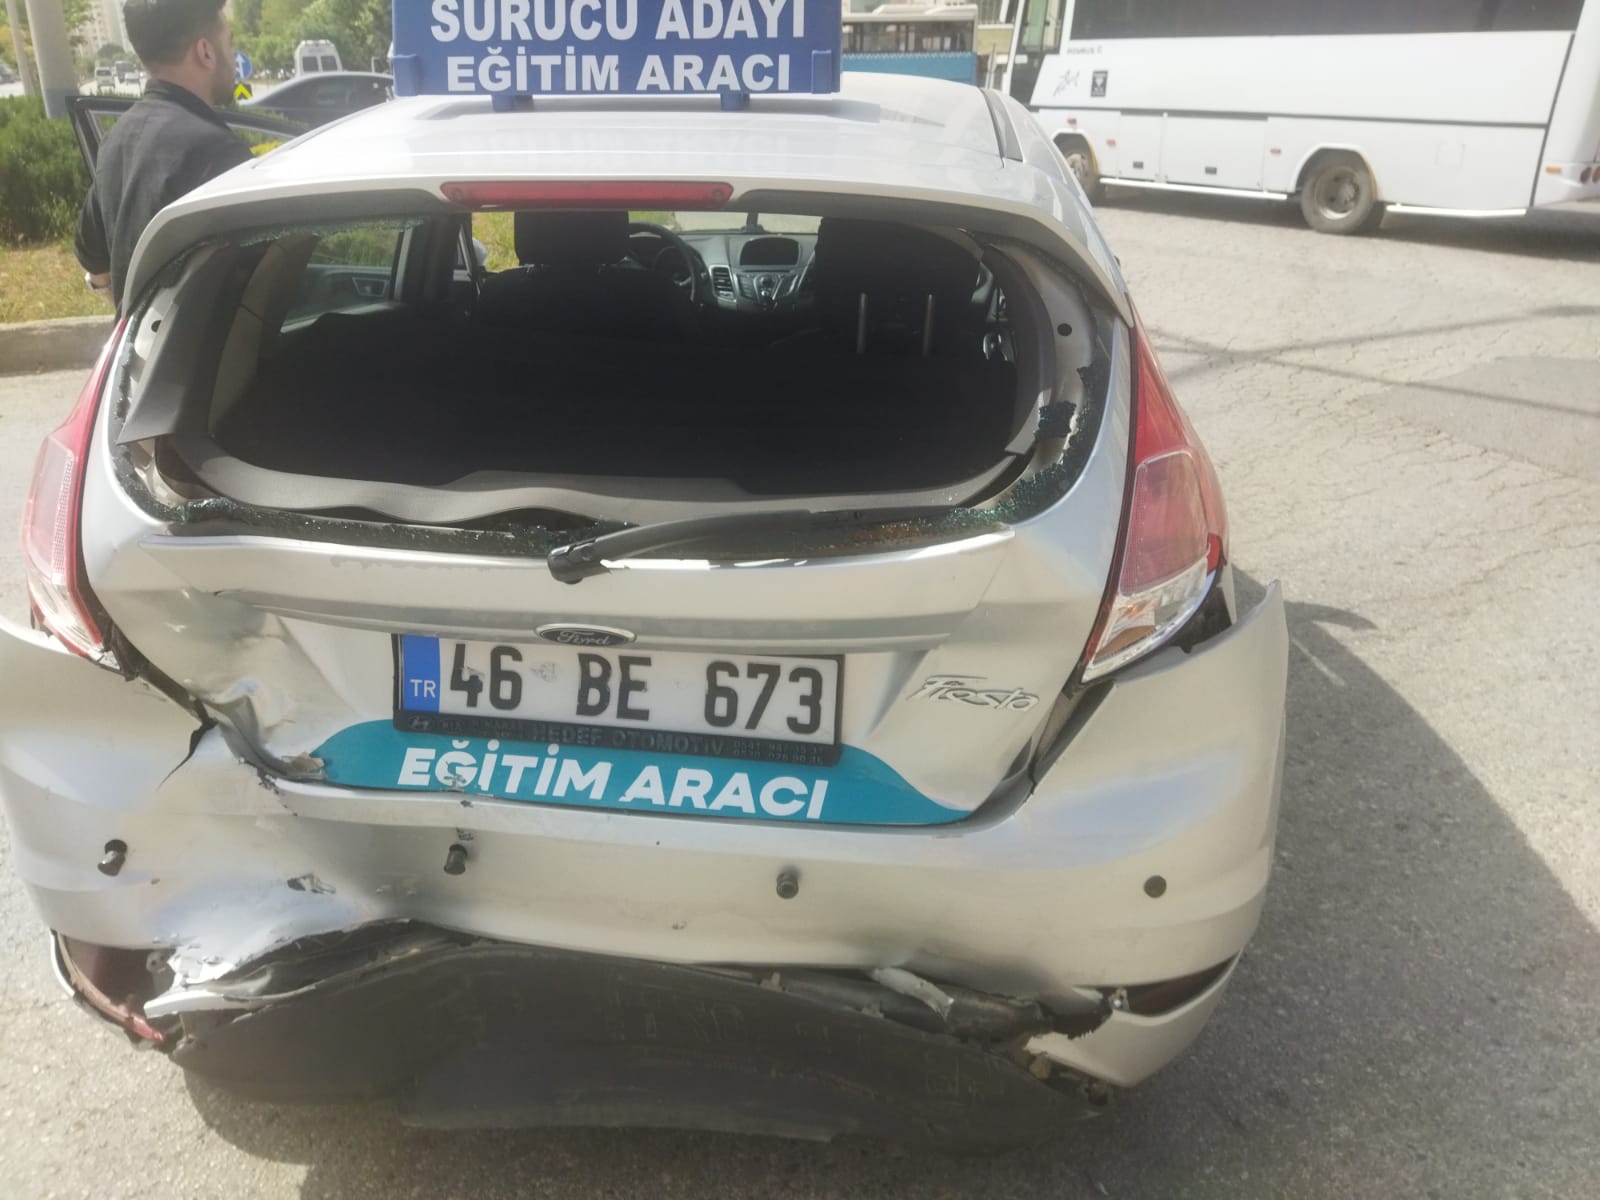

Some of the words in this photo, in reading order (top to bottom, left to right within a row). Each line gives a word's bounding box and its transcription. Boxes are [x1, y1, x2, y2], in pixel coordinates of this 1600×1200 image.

[447, 46, 620, 92] EĞİTİM
[636, 54, 790, 91] ARACI
[557, 630, 611, 646] Ford
[410, 679, 437, 698] TR
[450, 643, 524, 712] 46
[575, 653, 653, 721] BE
[704, 661, 824, 735] 673
[905, 675, 1040, 712] Fiesta
[397, 740, 614, 801] EĞİTİM
[619, 765, 829, 820] ARACI
